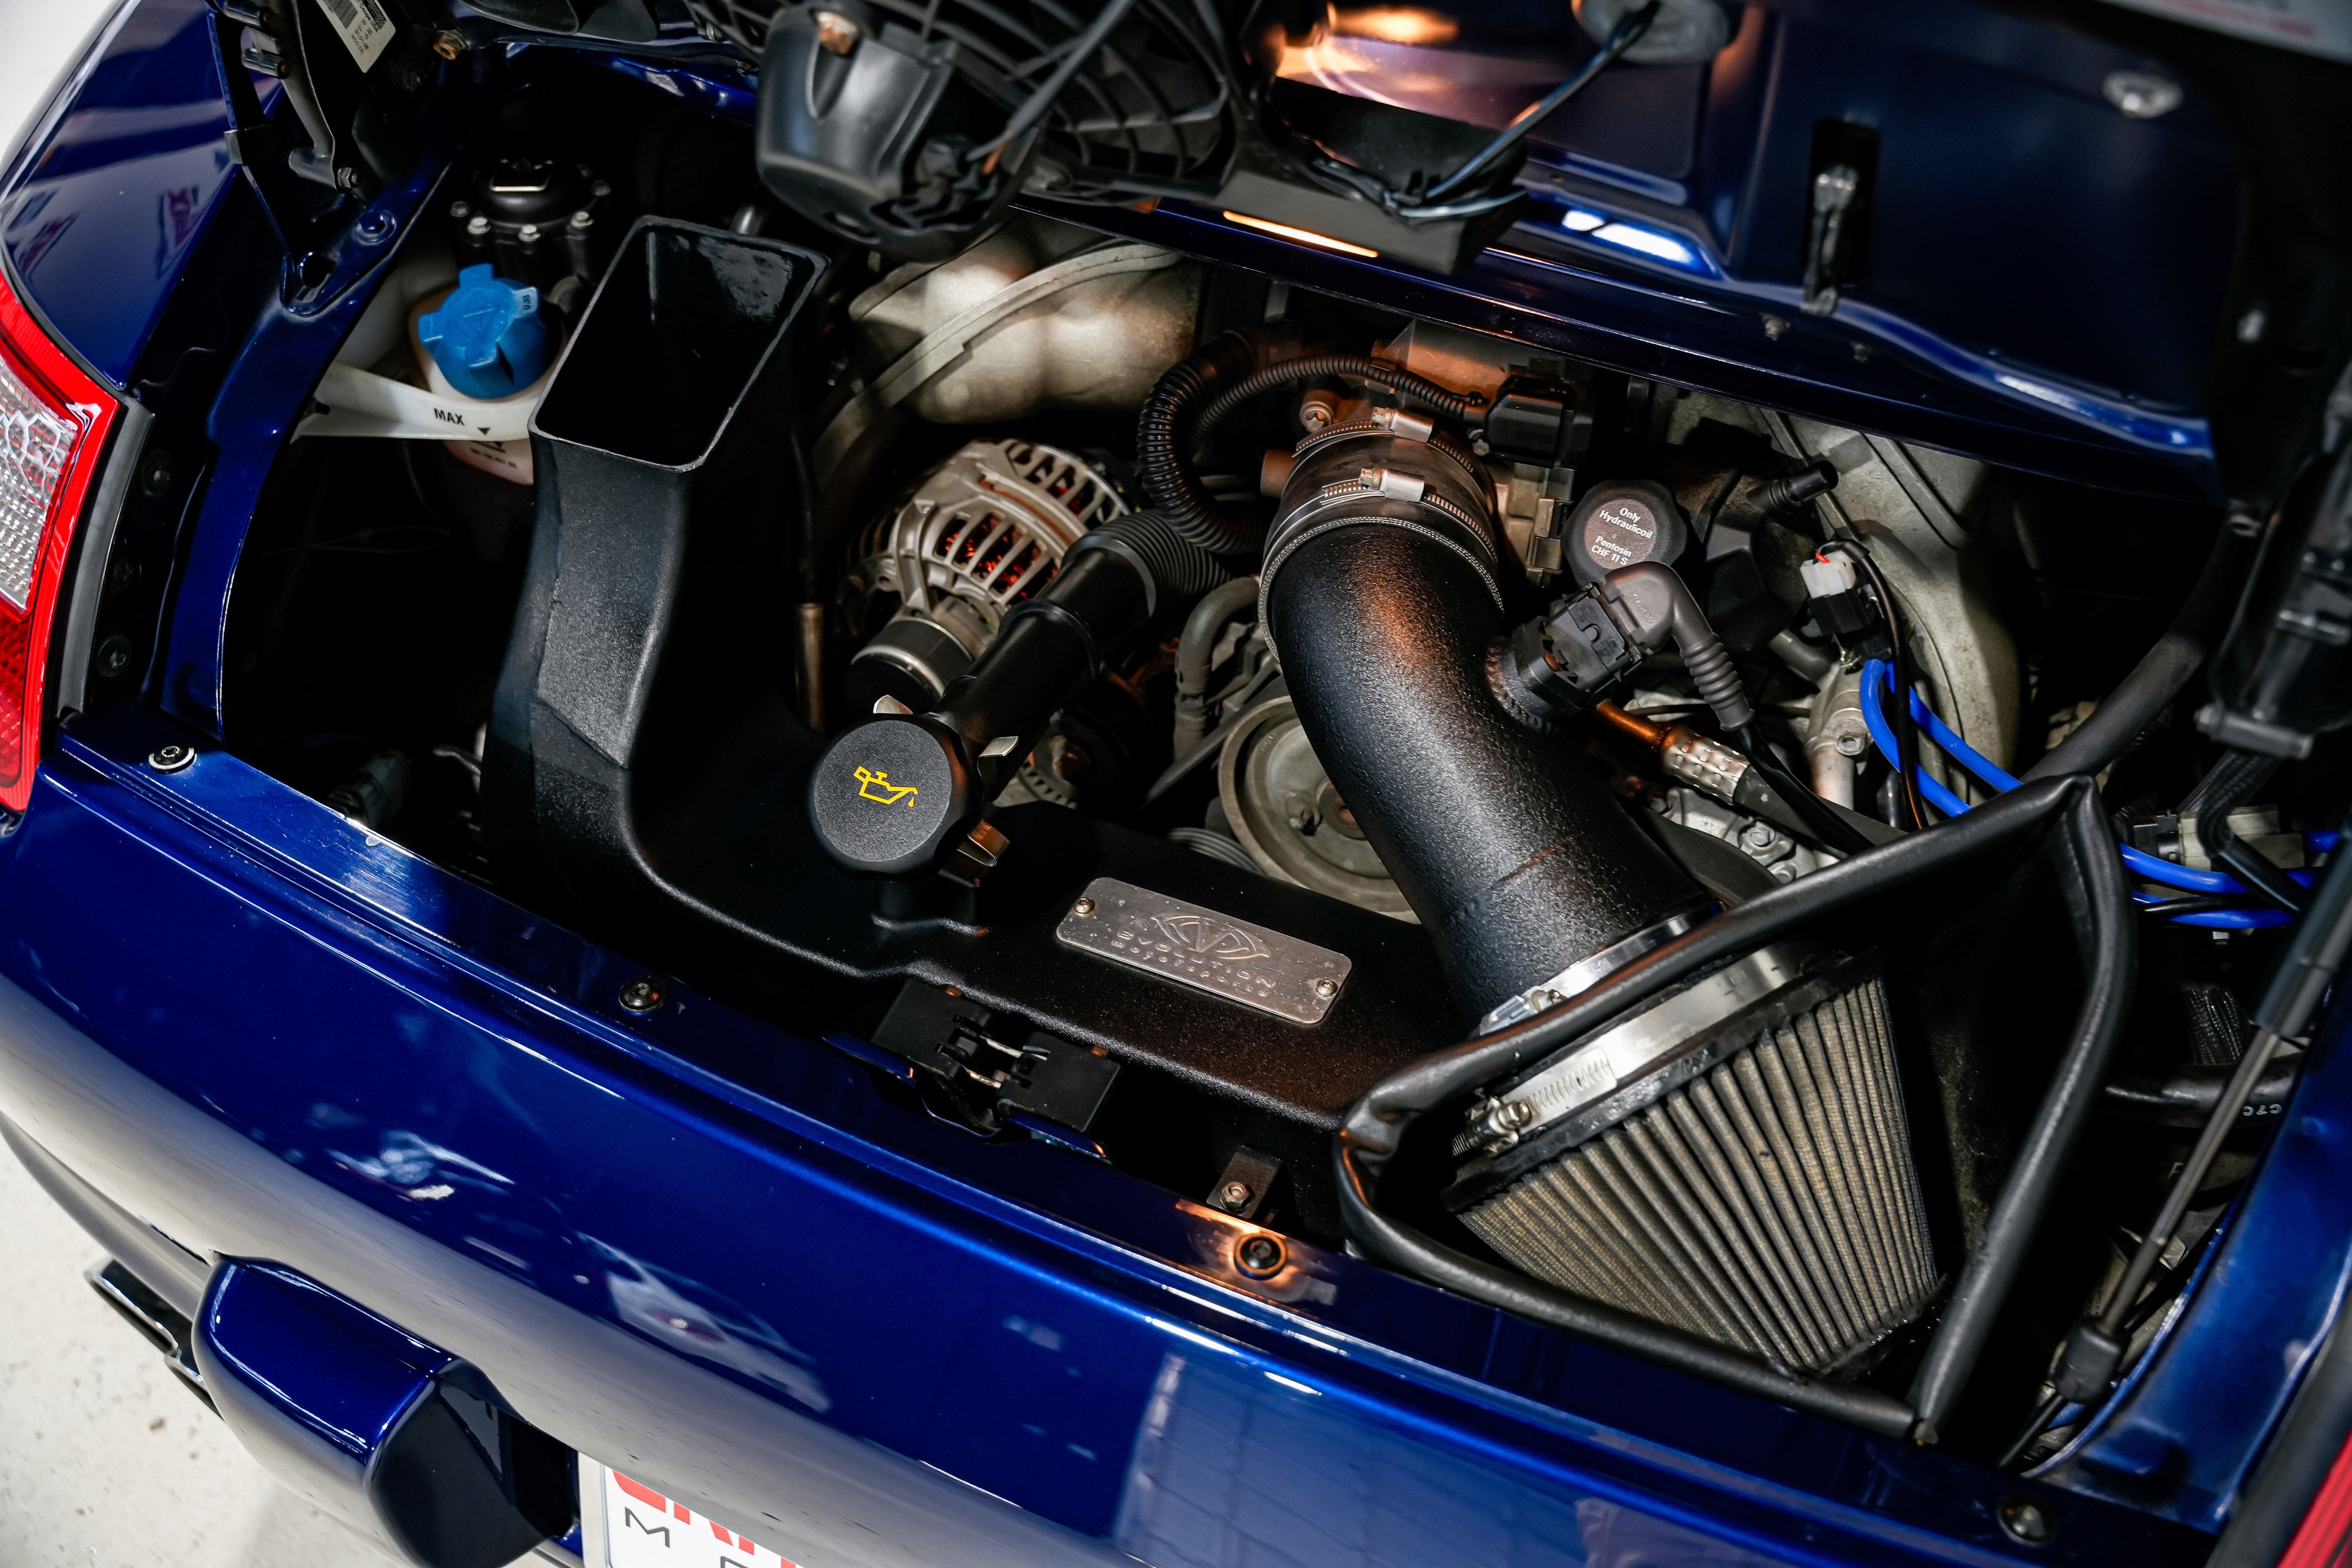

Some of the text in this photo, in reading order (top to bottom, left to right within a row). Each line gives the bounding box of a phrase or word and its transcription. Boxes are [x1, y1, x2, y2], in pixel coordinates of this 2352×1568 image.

[434, 408, 465, 425] MAX
[1619, 508, 1641, 523] Only
[1599, 510, 1653, 539] Hydraulicoil
[1591, 545, 1610, 557] CHF
[1595, 536, 1632, 557] Pentosin
